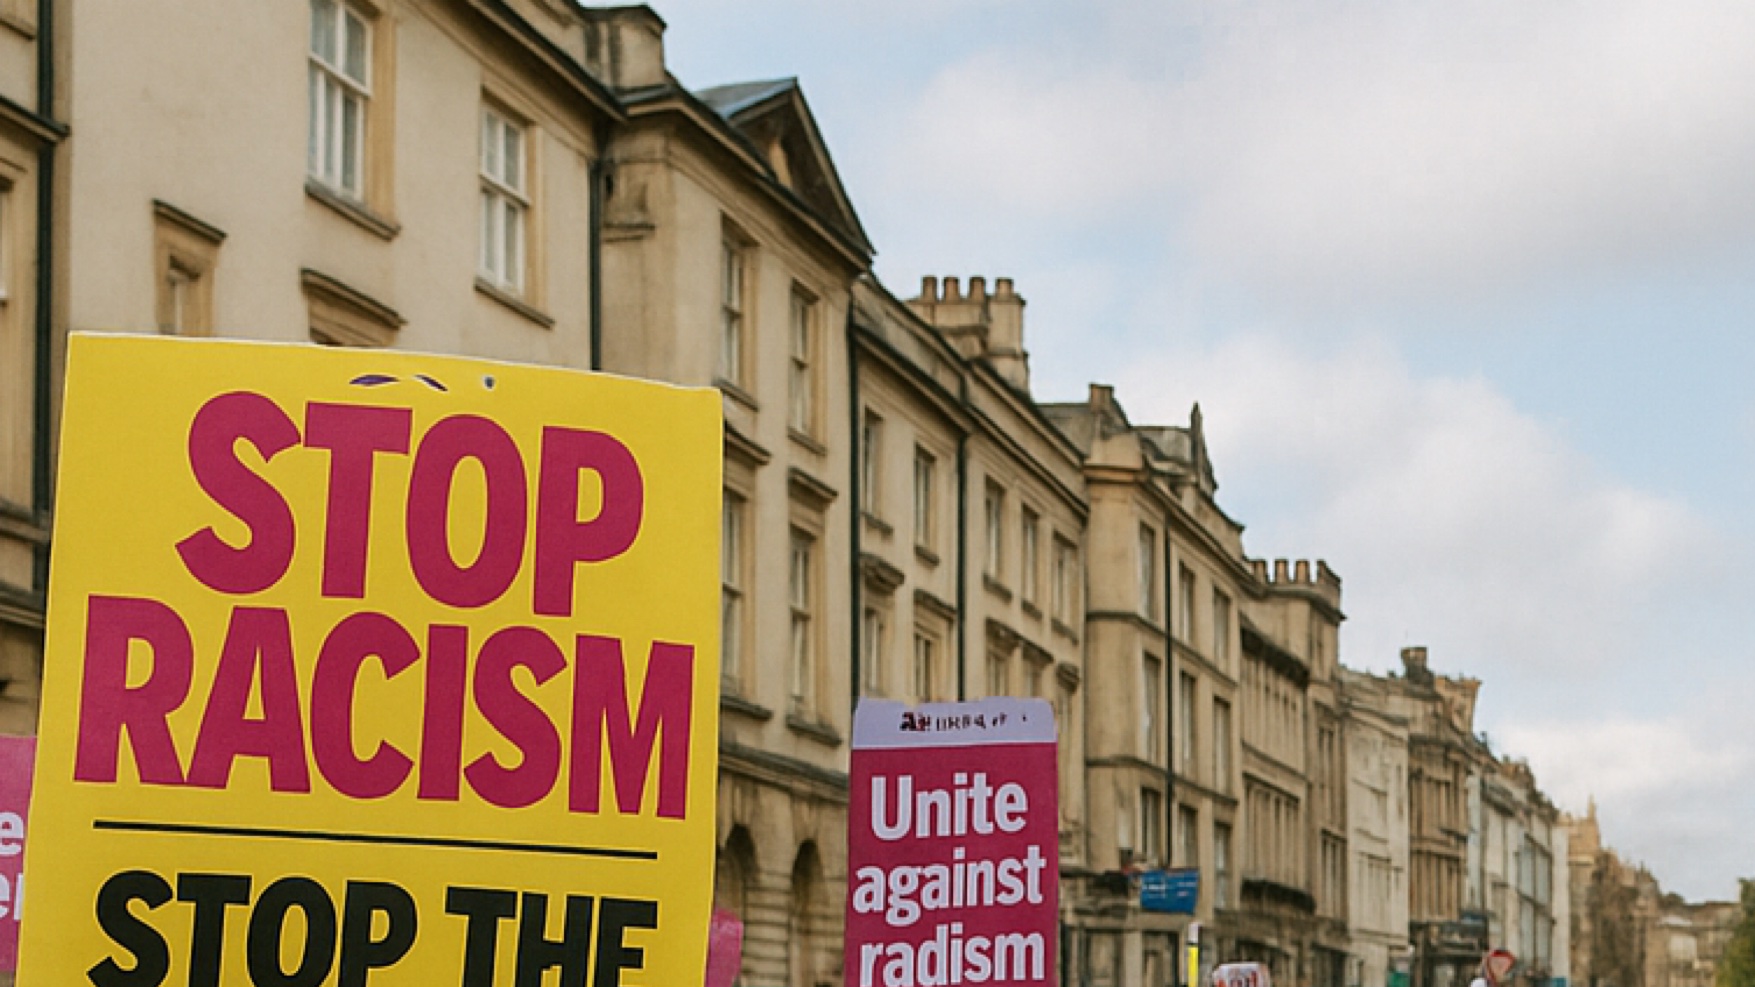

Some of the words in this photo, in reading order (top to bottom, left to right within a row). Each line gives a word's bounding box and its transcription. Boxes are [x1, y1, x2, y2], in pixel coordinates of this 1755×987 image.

[175, 391, 643, 617] STOP
[74, 595, 694, 820] RACISM
[871, 772, 1029, 841] Unite
[852, 845, 1047, 927] against
